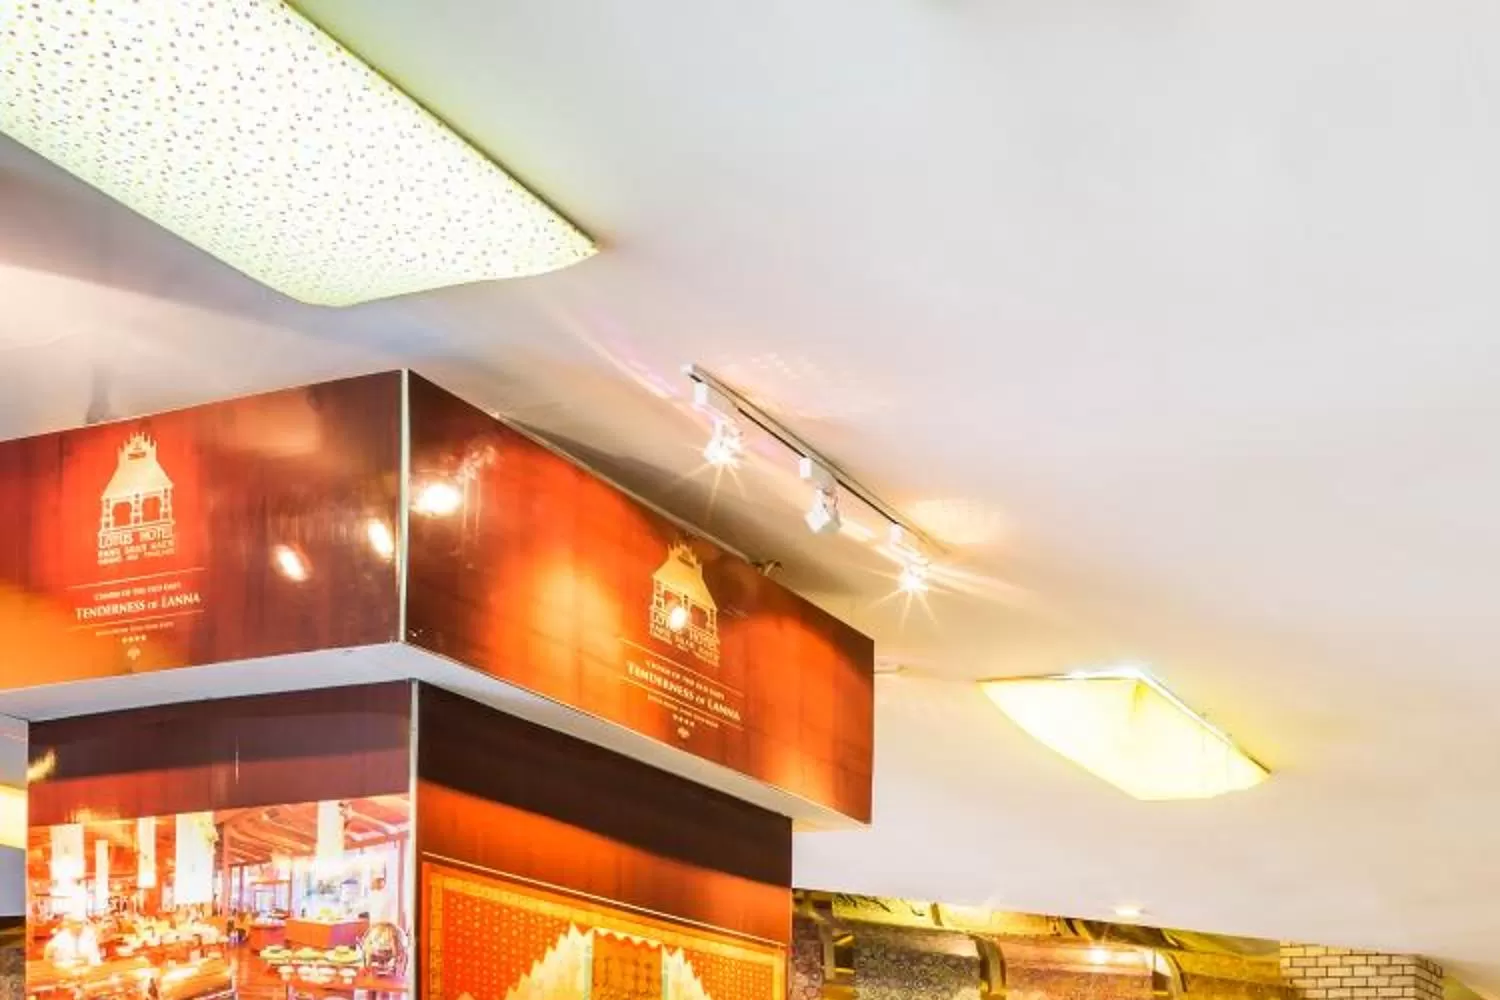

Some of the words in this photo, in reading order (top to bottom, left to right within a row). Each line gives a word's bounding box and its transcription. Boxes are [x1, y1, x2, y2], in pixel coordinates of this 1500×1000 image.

[75, 600, 145, 620] TENDERNESS
[161, 591, 200, 609] LANNA
[707, 697, 741, 721] LANNA
